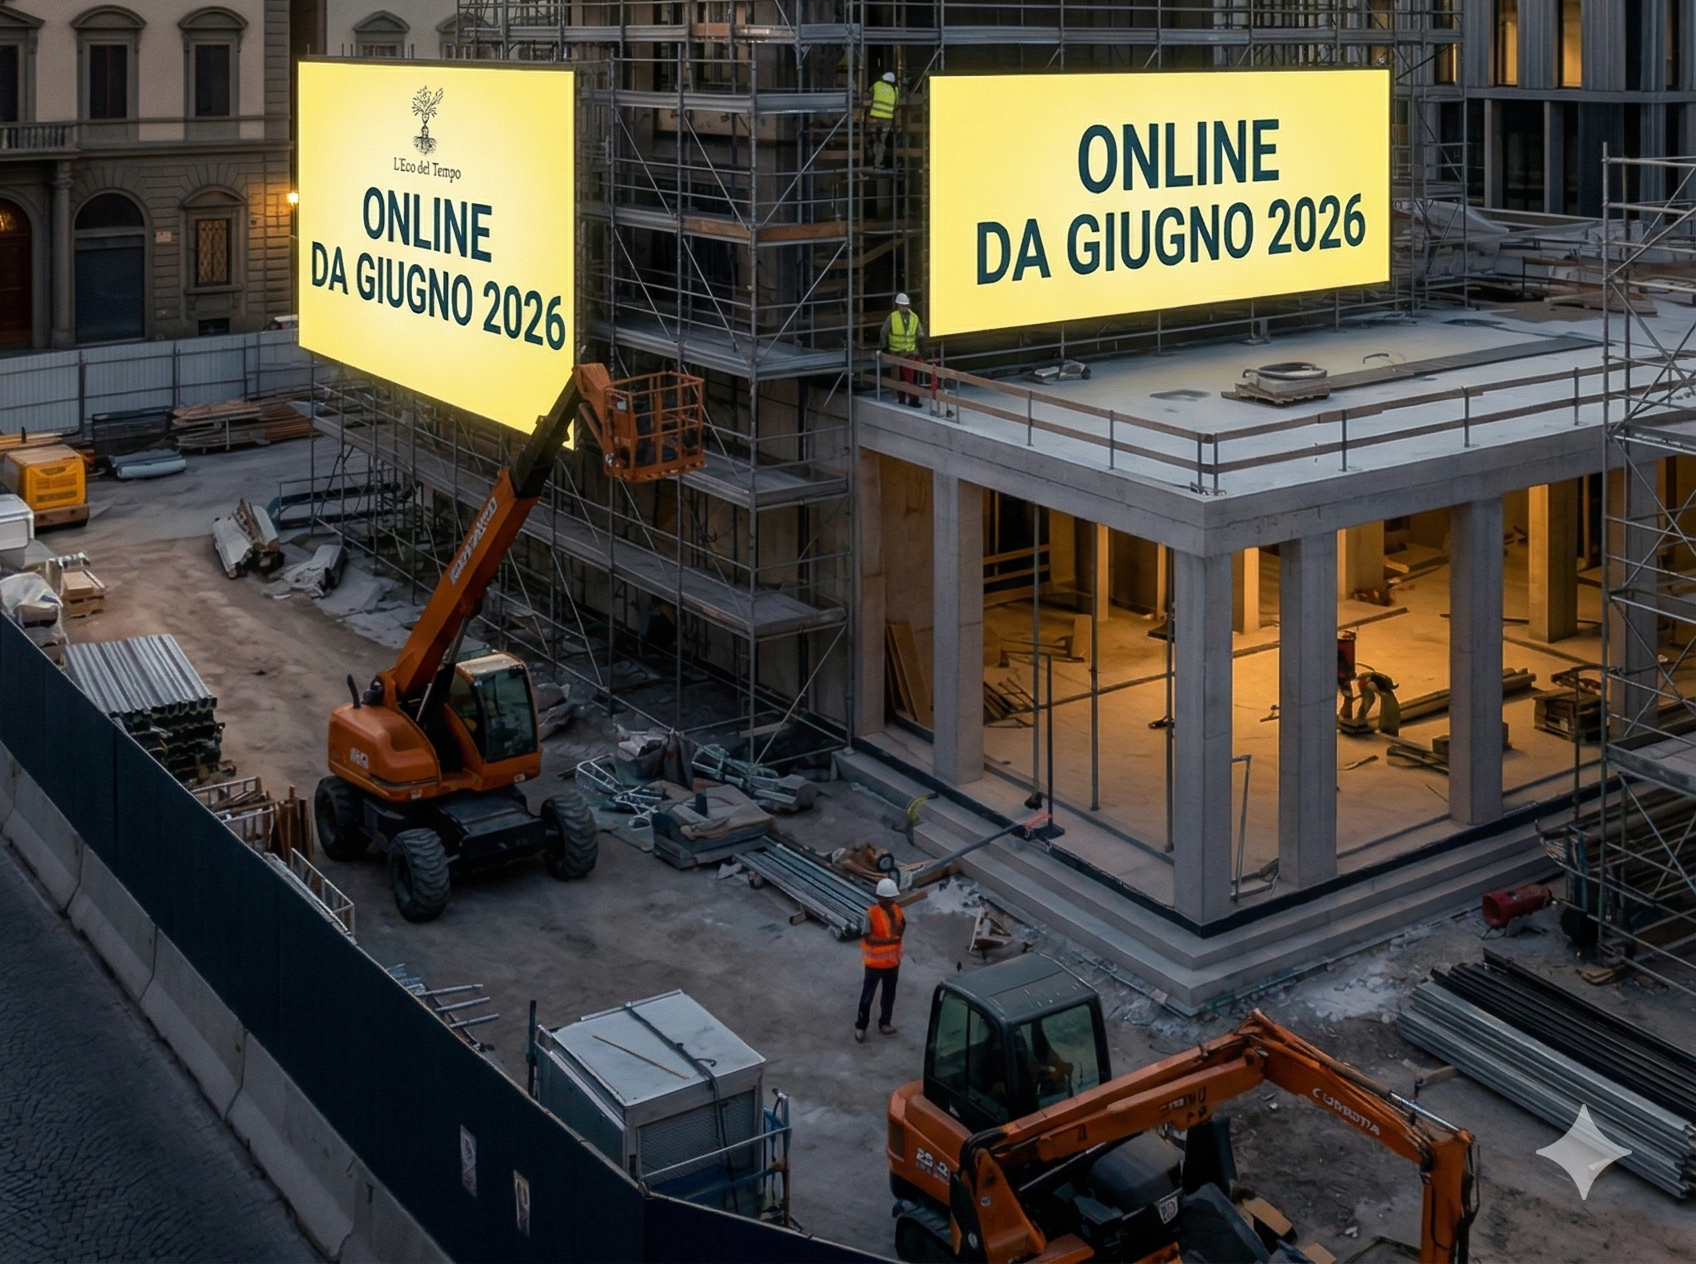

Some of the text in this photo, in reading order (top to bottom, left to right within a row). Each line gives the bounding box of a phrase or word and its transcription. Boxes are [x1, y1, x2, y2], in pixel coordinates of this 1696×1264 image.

[393, 156, 462, 184] L'Eco del Tempo
[1078, 119, 1280, 195] ONLINE
[363, 186, 493, 263] ONLINE
[976, 192, 1366, 286] DA GIUGNO 2026
[311, 241, 566, 351] DA GIUGNO 2026
